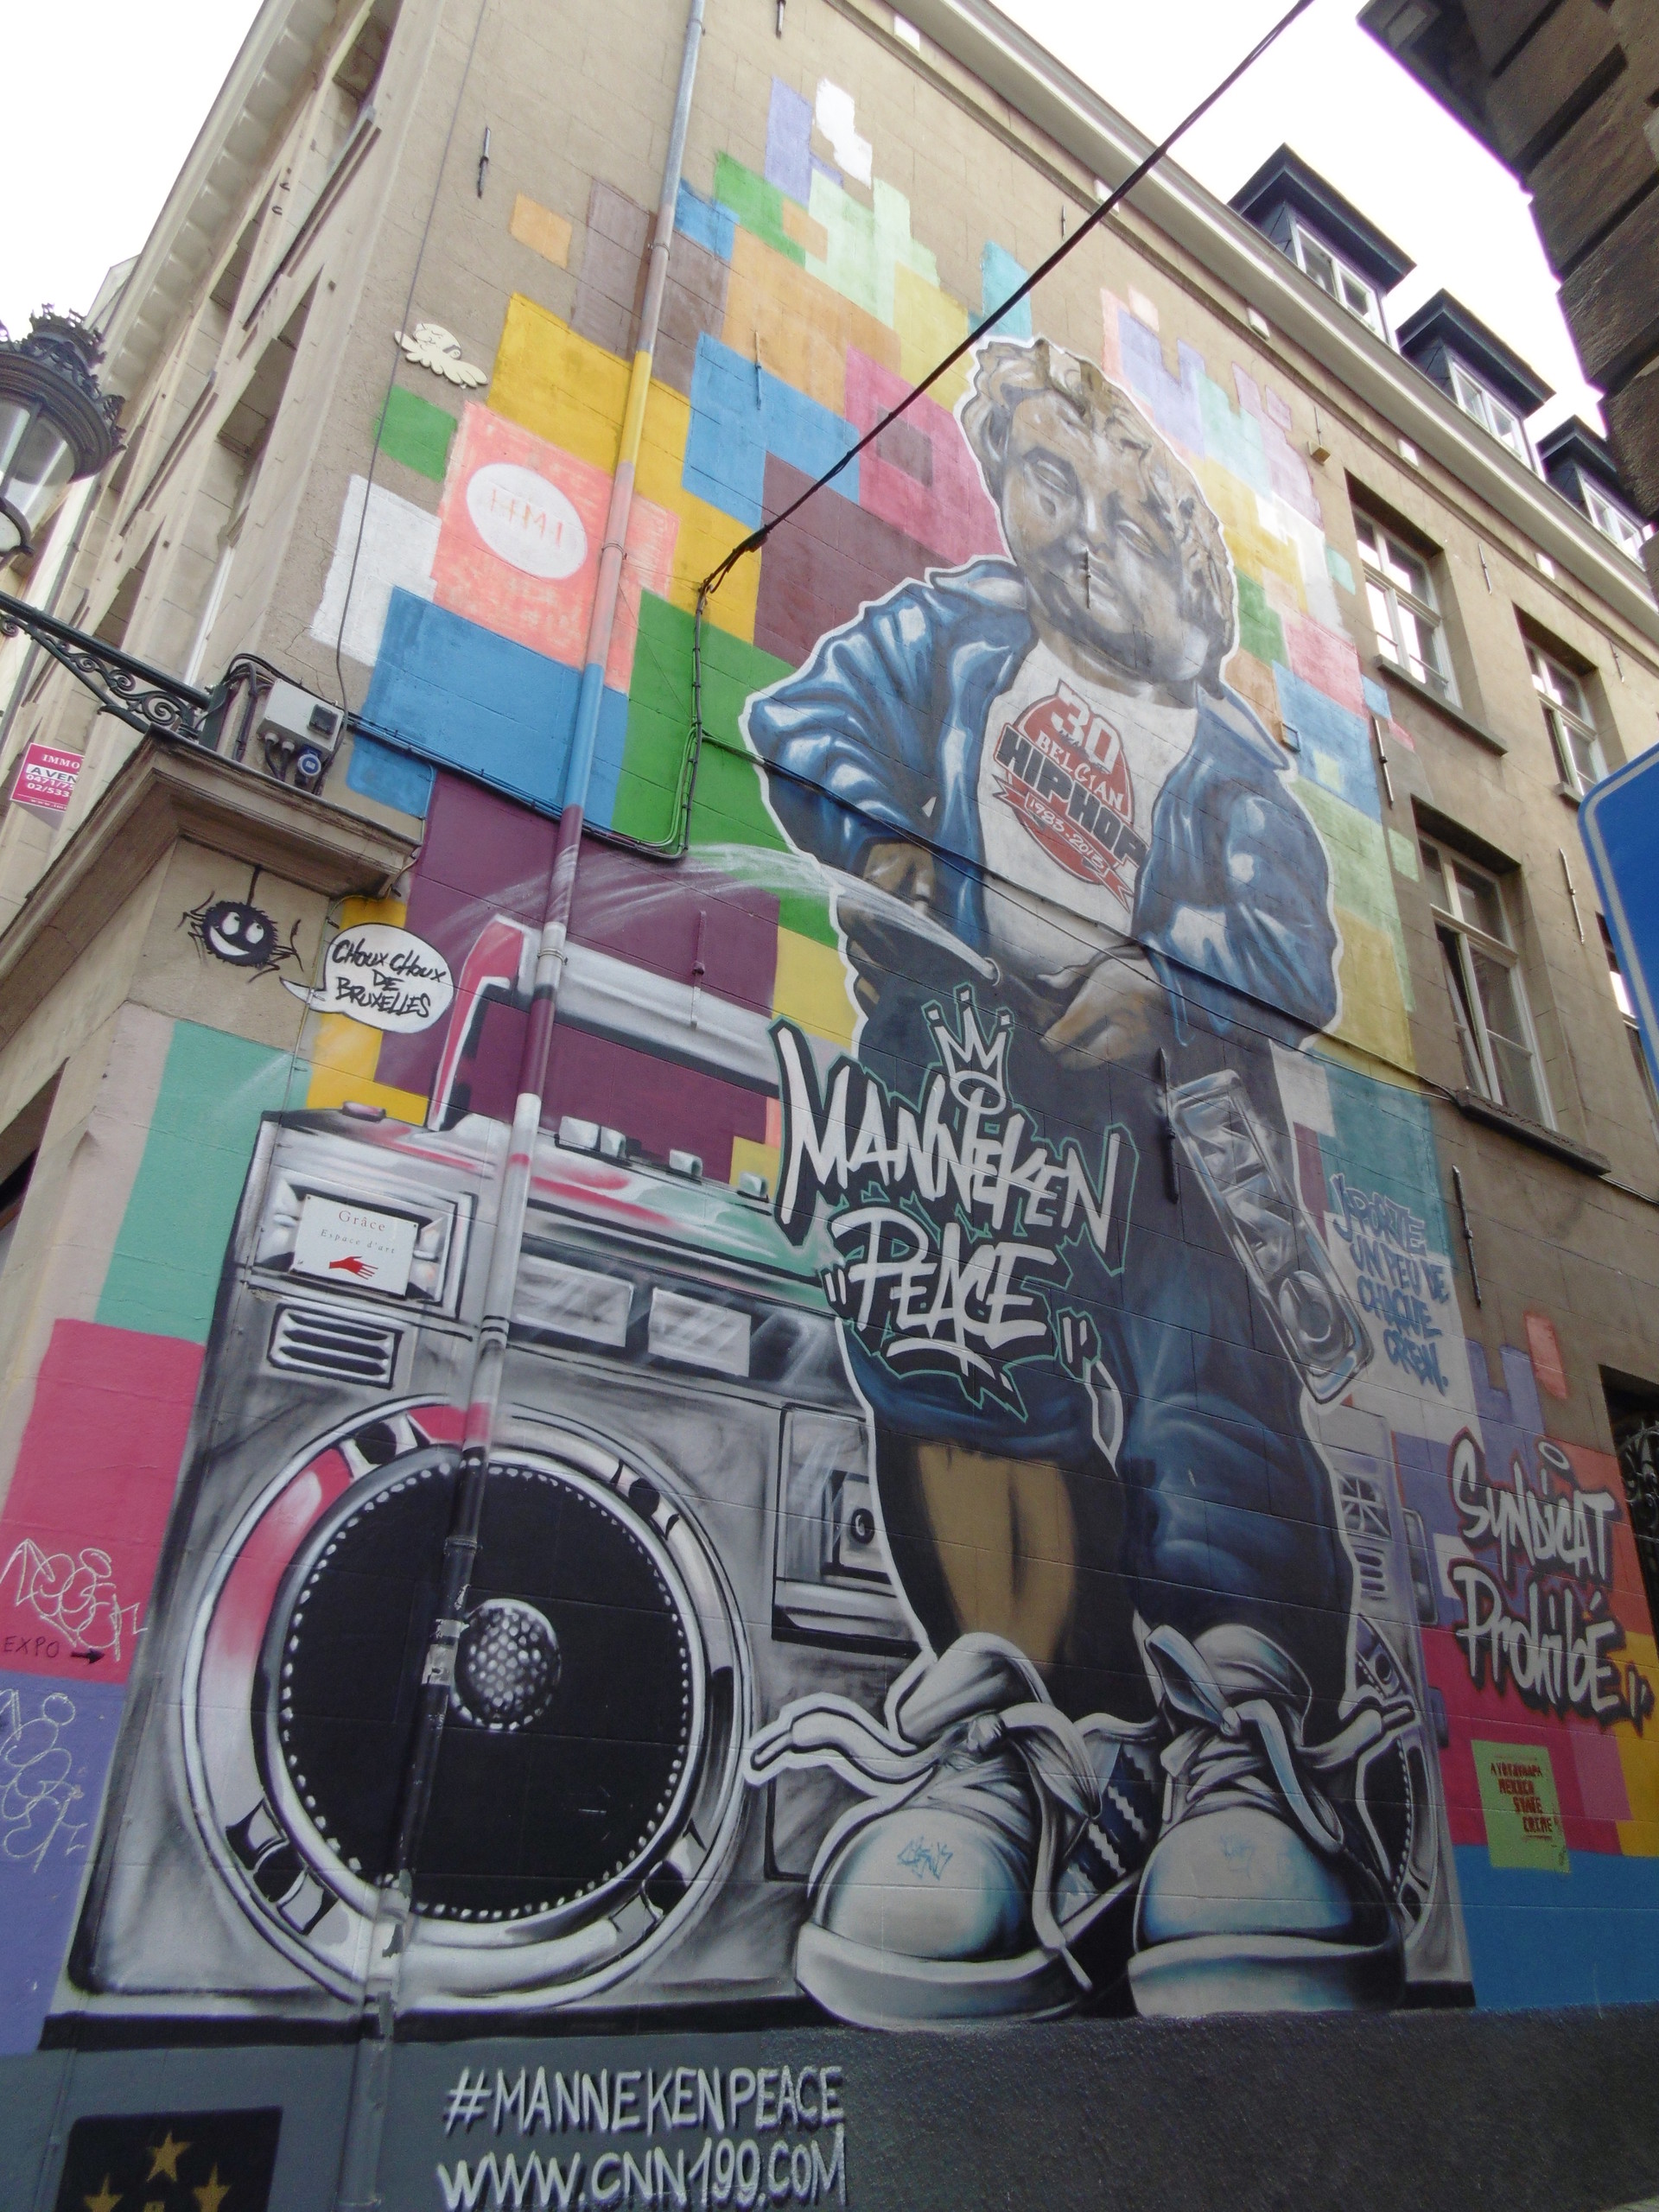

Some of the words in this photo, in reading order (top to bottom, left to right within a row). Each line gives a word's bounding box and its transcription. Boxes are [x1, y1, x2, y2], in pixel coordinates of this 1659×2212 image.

[1051, 678, 1124, 774] 30
[31, 766, 42, 776] A
[42, 753, 80, 770] IMMO
[1036, 730, 1123, 810] BELGIAN
[27, 783, 70, 798] 02/533
[372, 969, 404, 991] DE
[335, 976, 430, 1018] BRUXELLES
[777, 1027, 1121, 1254] MANNEKEN
[339, 1210, 385, 1231] Grâce
[321, 1229, 361, 1245] Espace
[366, 1241, 395, 1254] d'art
[3, 1635, 60, 1658] EXPO
[1522, 1816, 1553, 1833] CRIME
